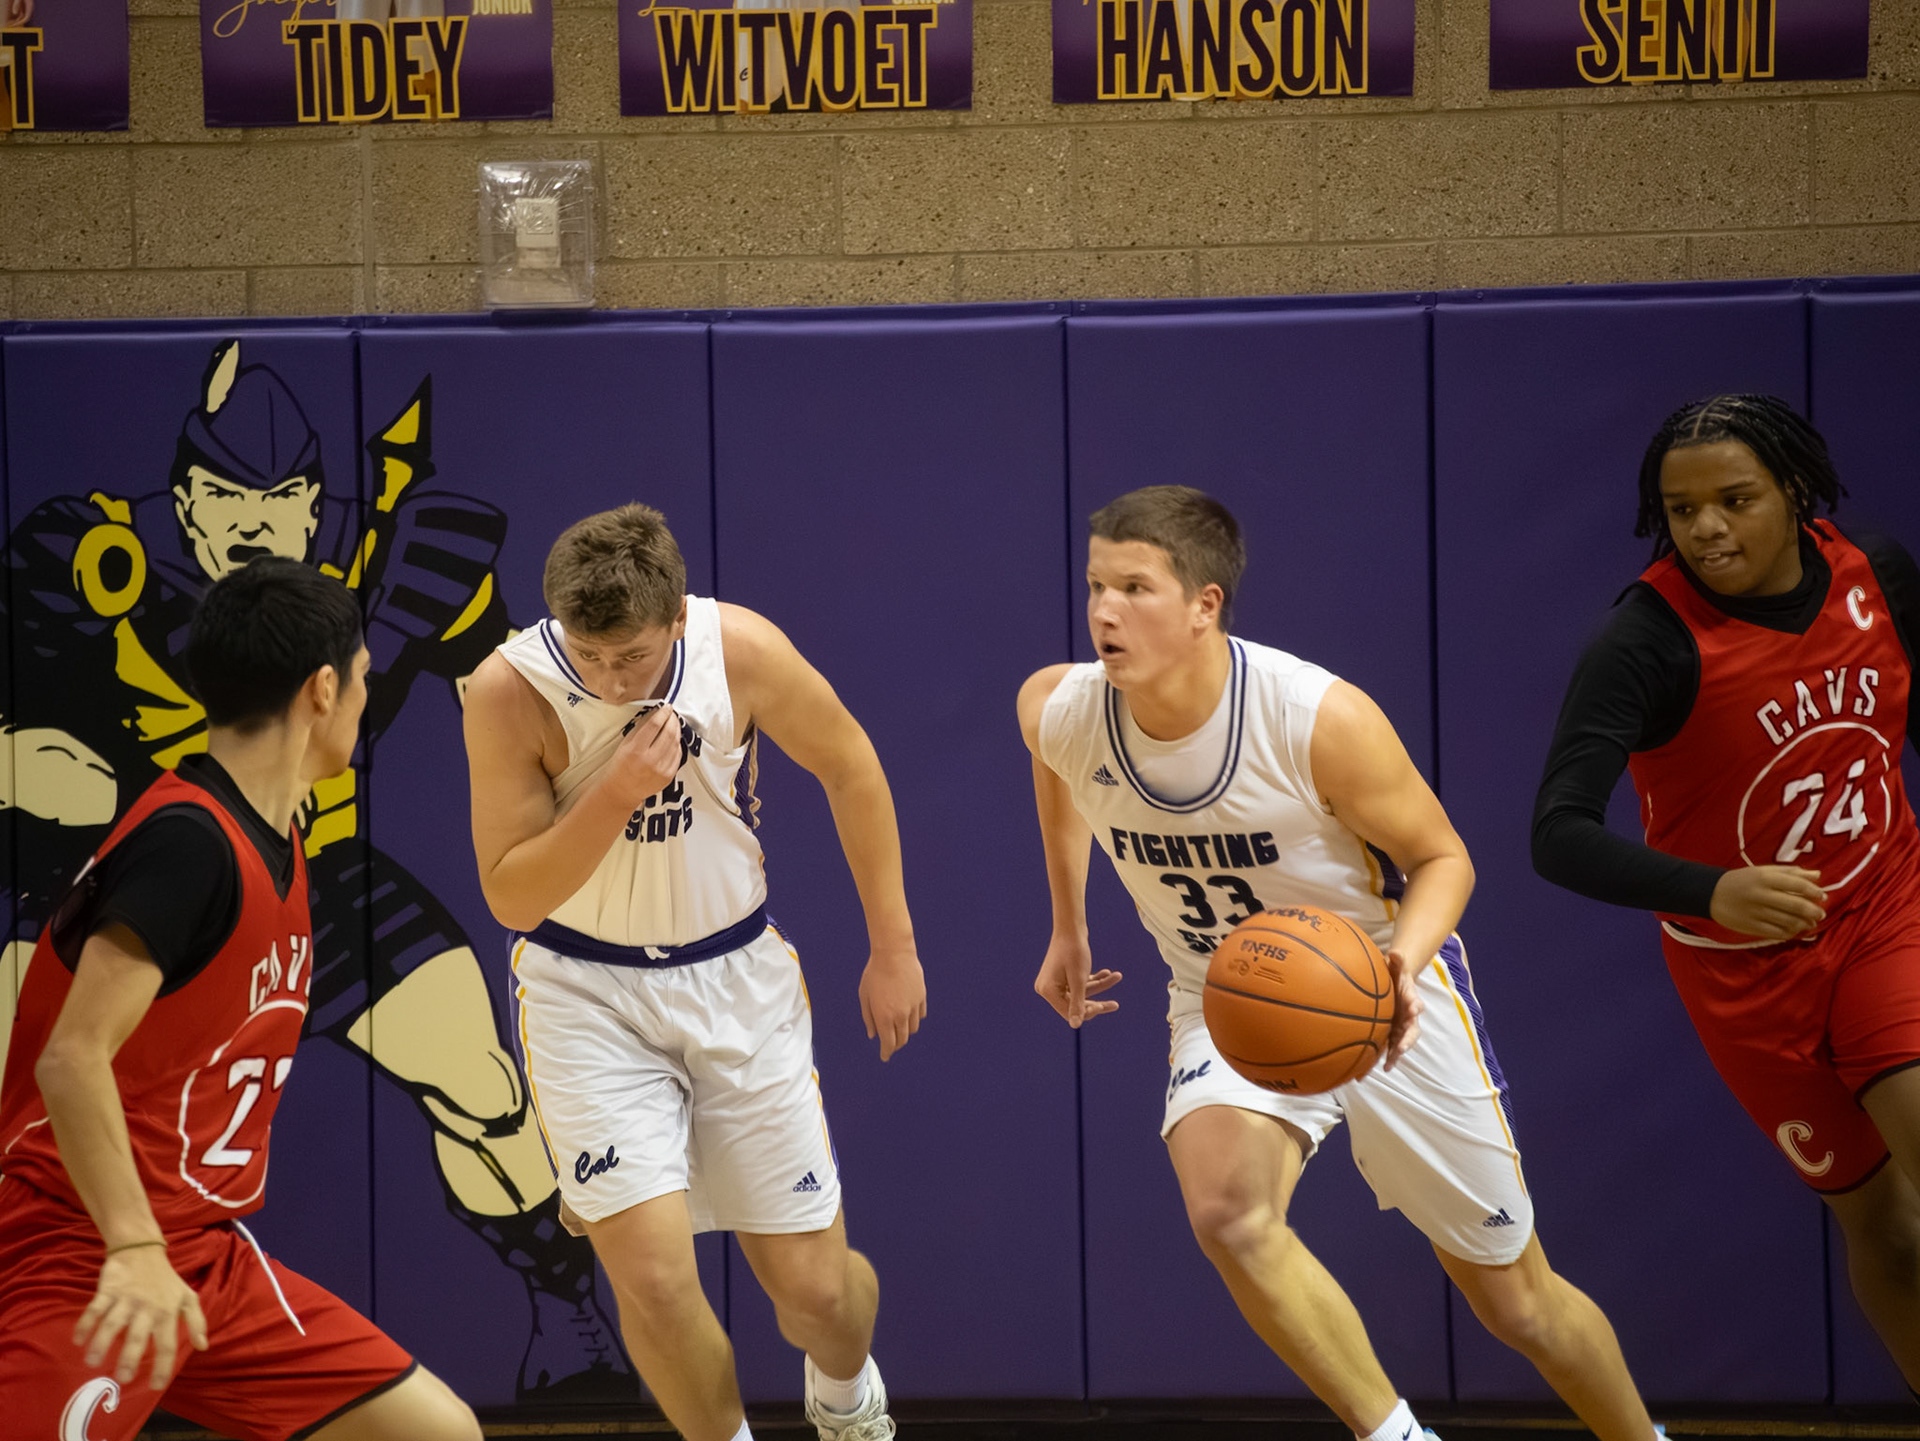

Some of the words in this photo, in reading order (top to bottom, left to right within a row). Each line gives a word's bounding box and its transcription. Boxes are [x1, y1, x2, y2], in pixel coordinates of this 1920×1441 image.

[282, 15, 469, 122] TIDEY
[653, 5, 938, 112] WITVOET
[1097, 0, 1368, 99] HANSON
[1847, 586, 1874, 631] C
[1757, 667, 1879, 745] CAVS
[625, 796, 693, 843] SOTS
[1775, 758, 1868, 862] 24
[1110, 826, 1280, 868] FIGHTING
[1160, 873, 1265, 928] 33
[249, 934, 311, 1013] CAV
[1247, 941, 1288, 961] NFHS
[200, 1057, 293, 1166] 2
[574, 1145, 620, 1184] Cal
[1776, 1120, 1834, 1177] C
